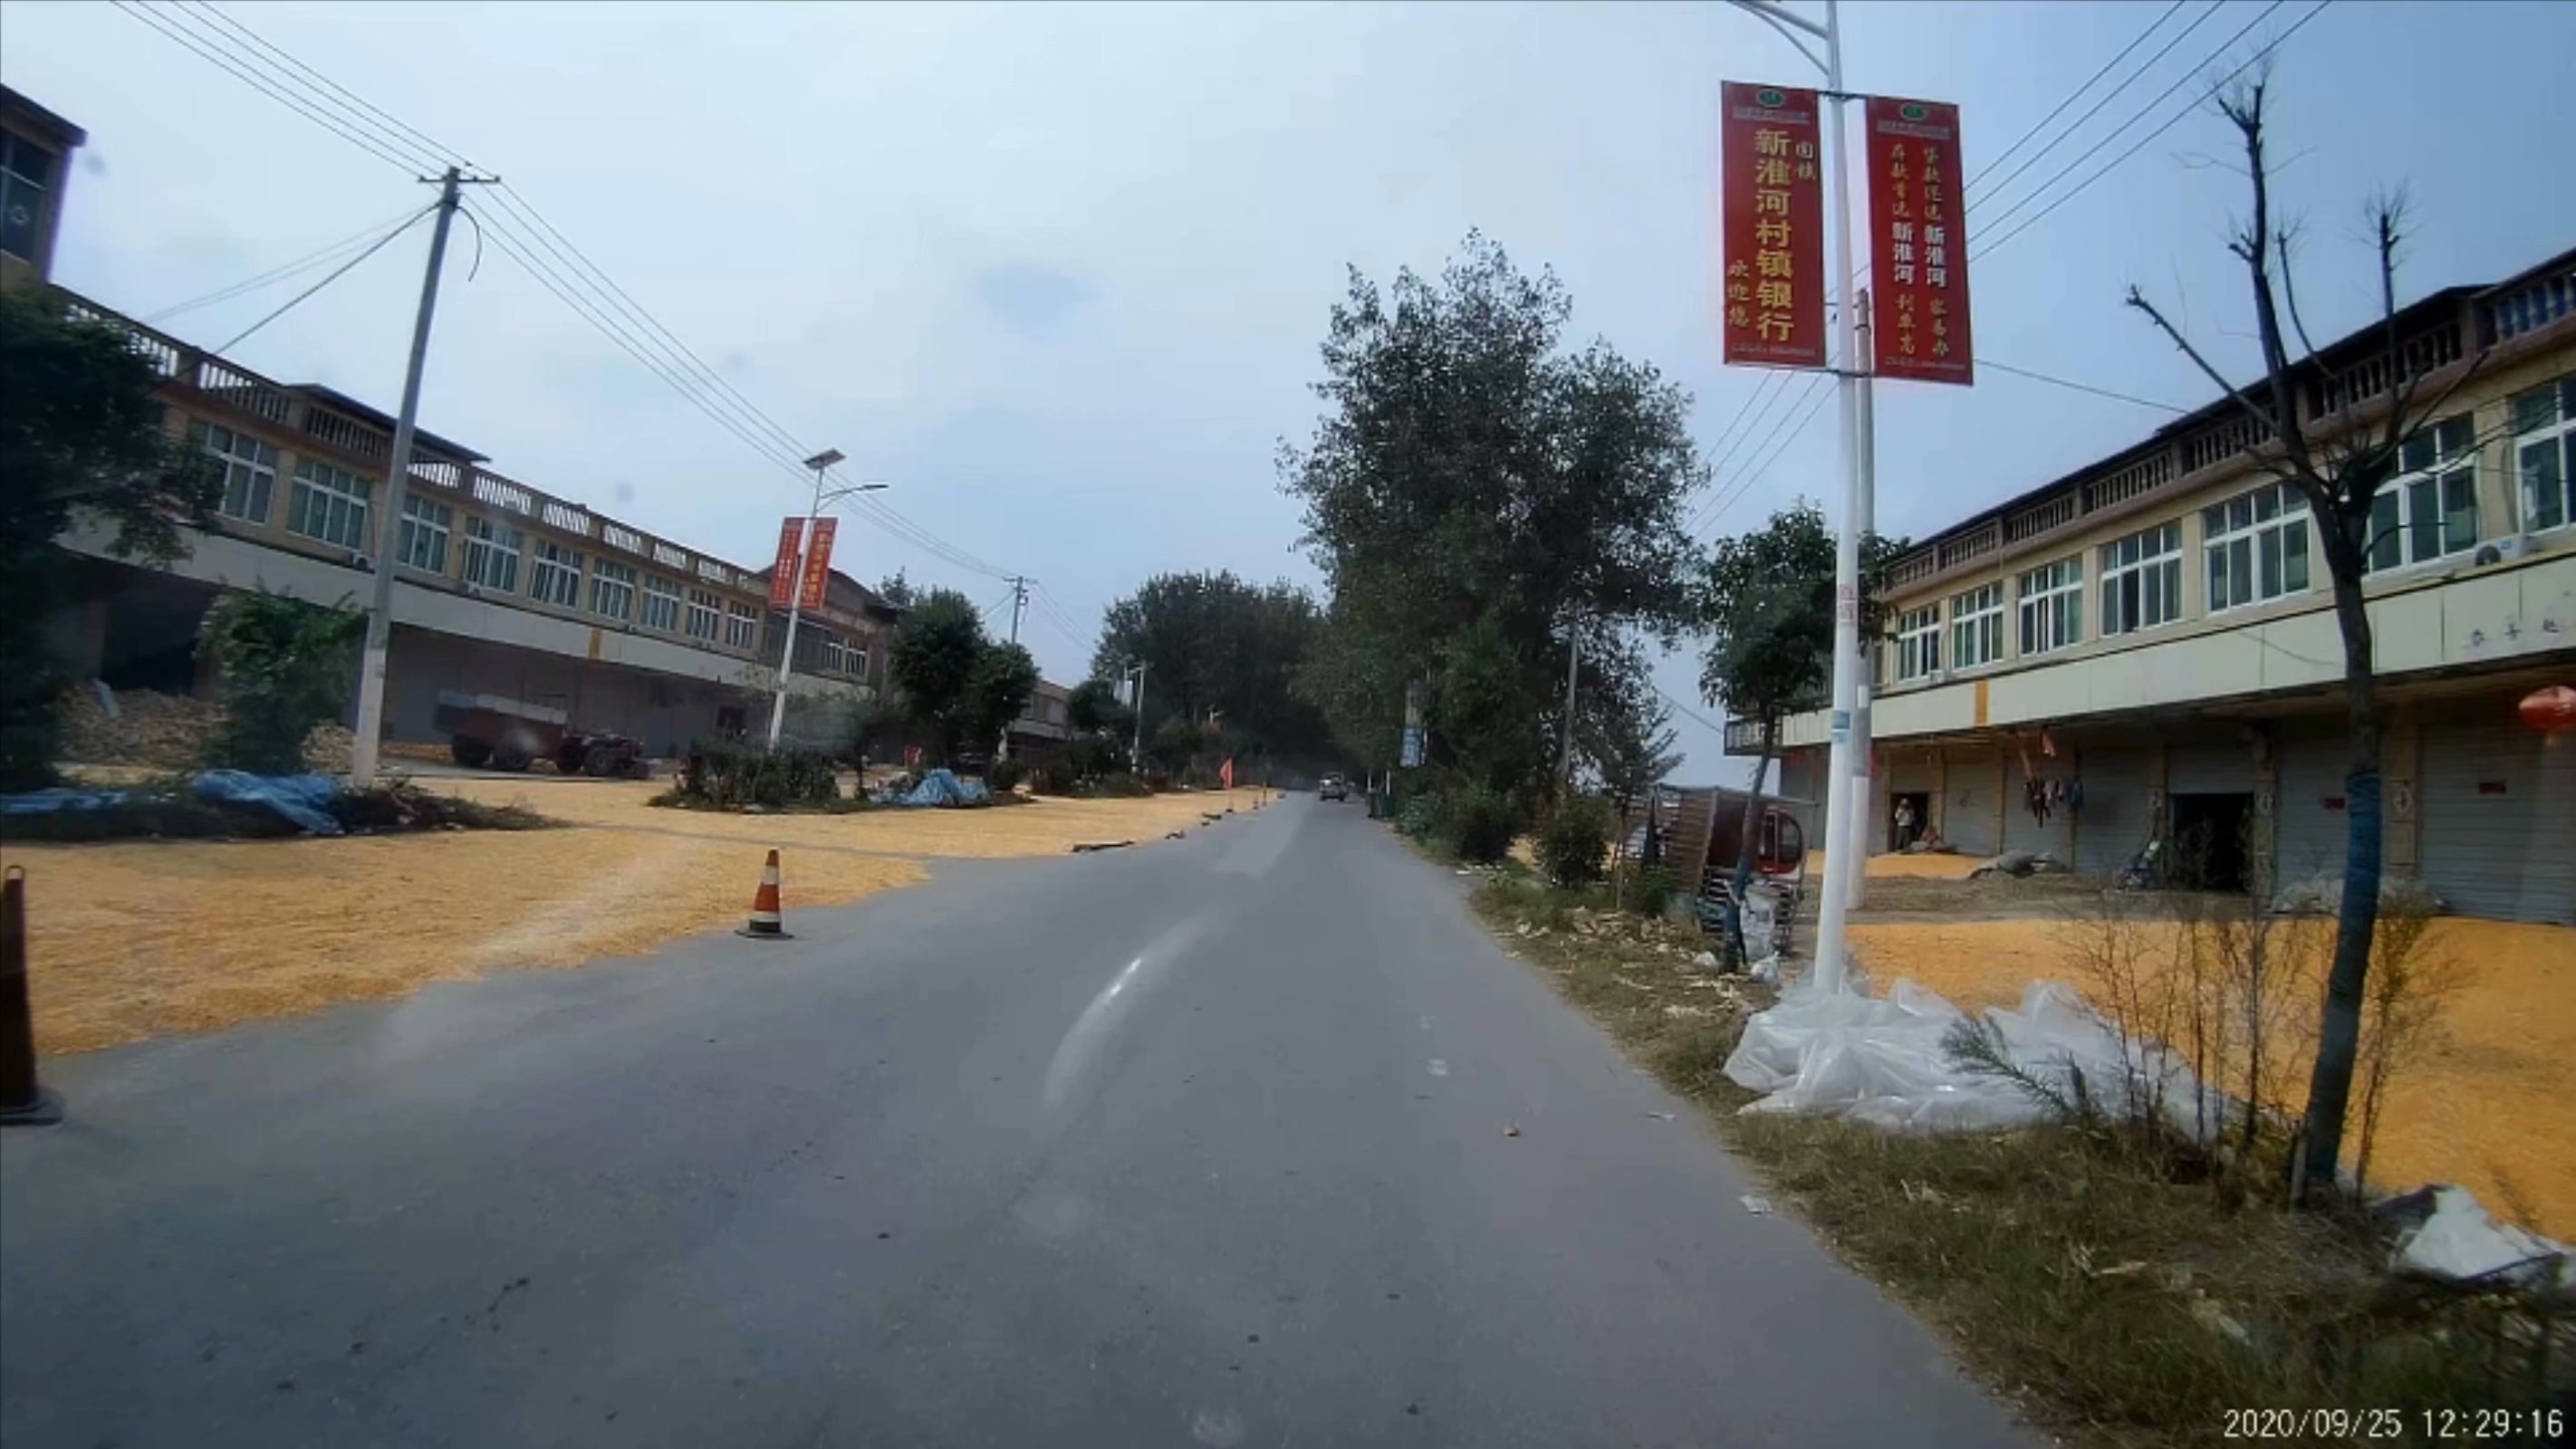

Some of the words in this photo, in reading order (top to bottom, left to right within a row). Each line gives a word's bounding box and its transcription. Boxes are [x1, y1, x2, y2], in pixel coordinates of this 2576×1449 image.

[1754, 128, 1794, 342] 新淮河村镇银行
